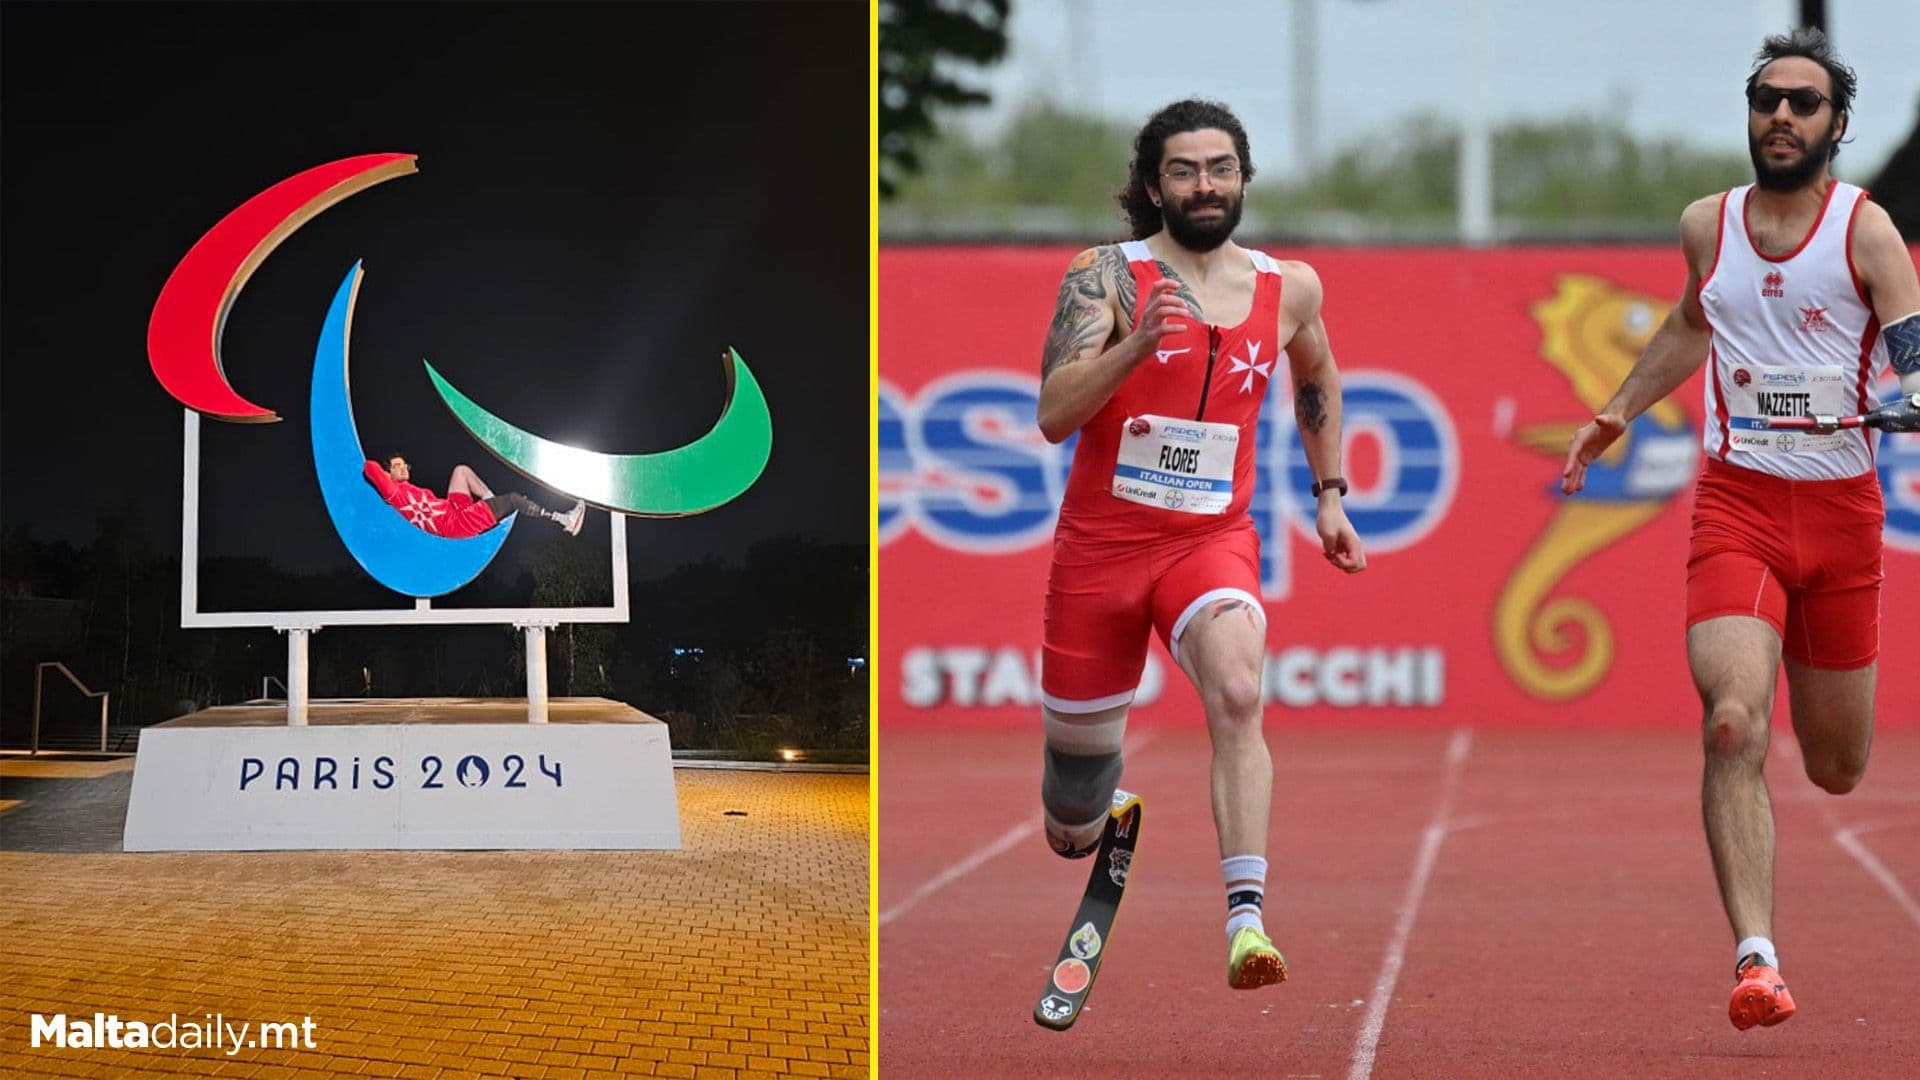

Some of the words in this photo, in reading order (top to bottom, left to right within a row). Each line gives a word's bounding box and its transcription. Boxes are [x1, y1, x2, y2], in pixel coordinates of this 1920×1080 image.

[1757, 392, 1810, 417] MAZZETTE
[1741, 437, 1769, 446] UniCredit
[1158, 445, 1200, 474] FLORES
[1140, 471, 1184, 487] ITALIAN
[1186, 480, 1212, 490] OPEN
[1125, 486, 1156, 499] UniCredit
[239, 756, 395, 791] PARIS
